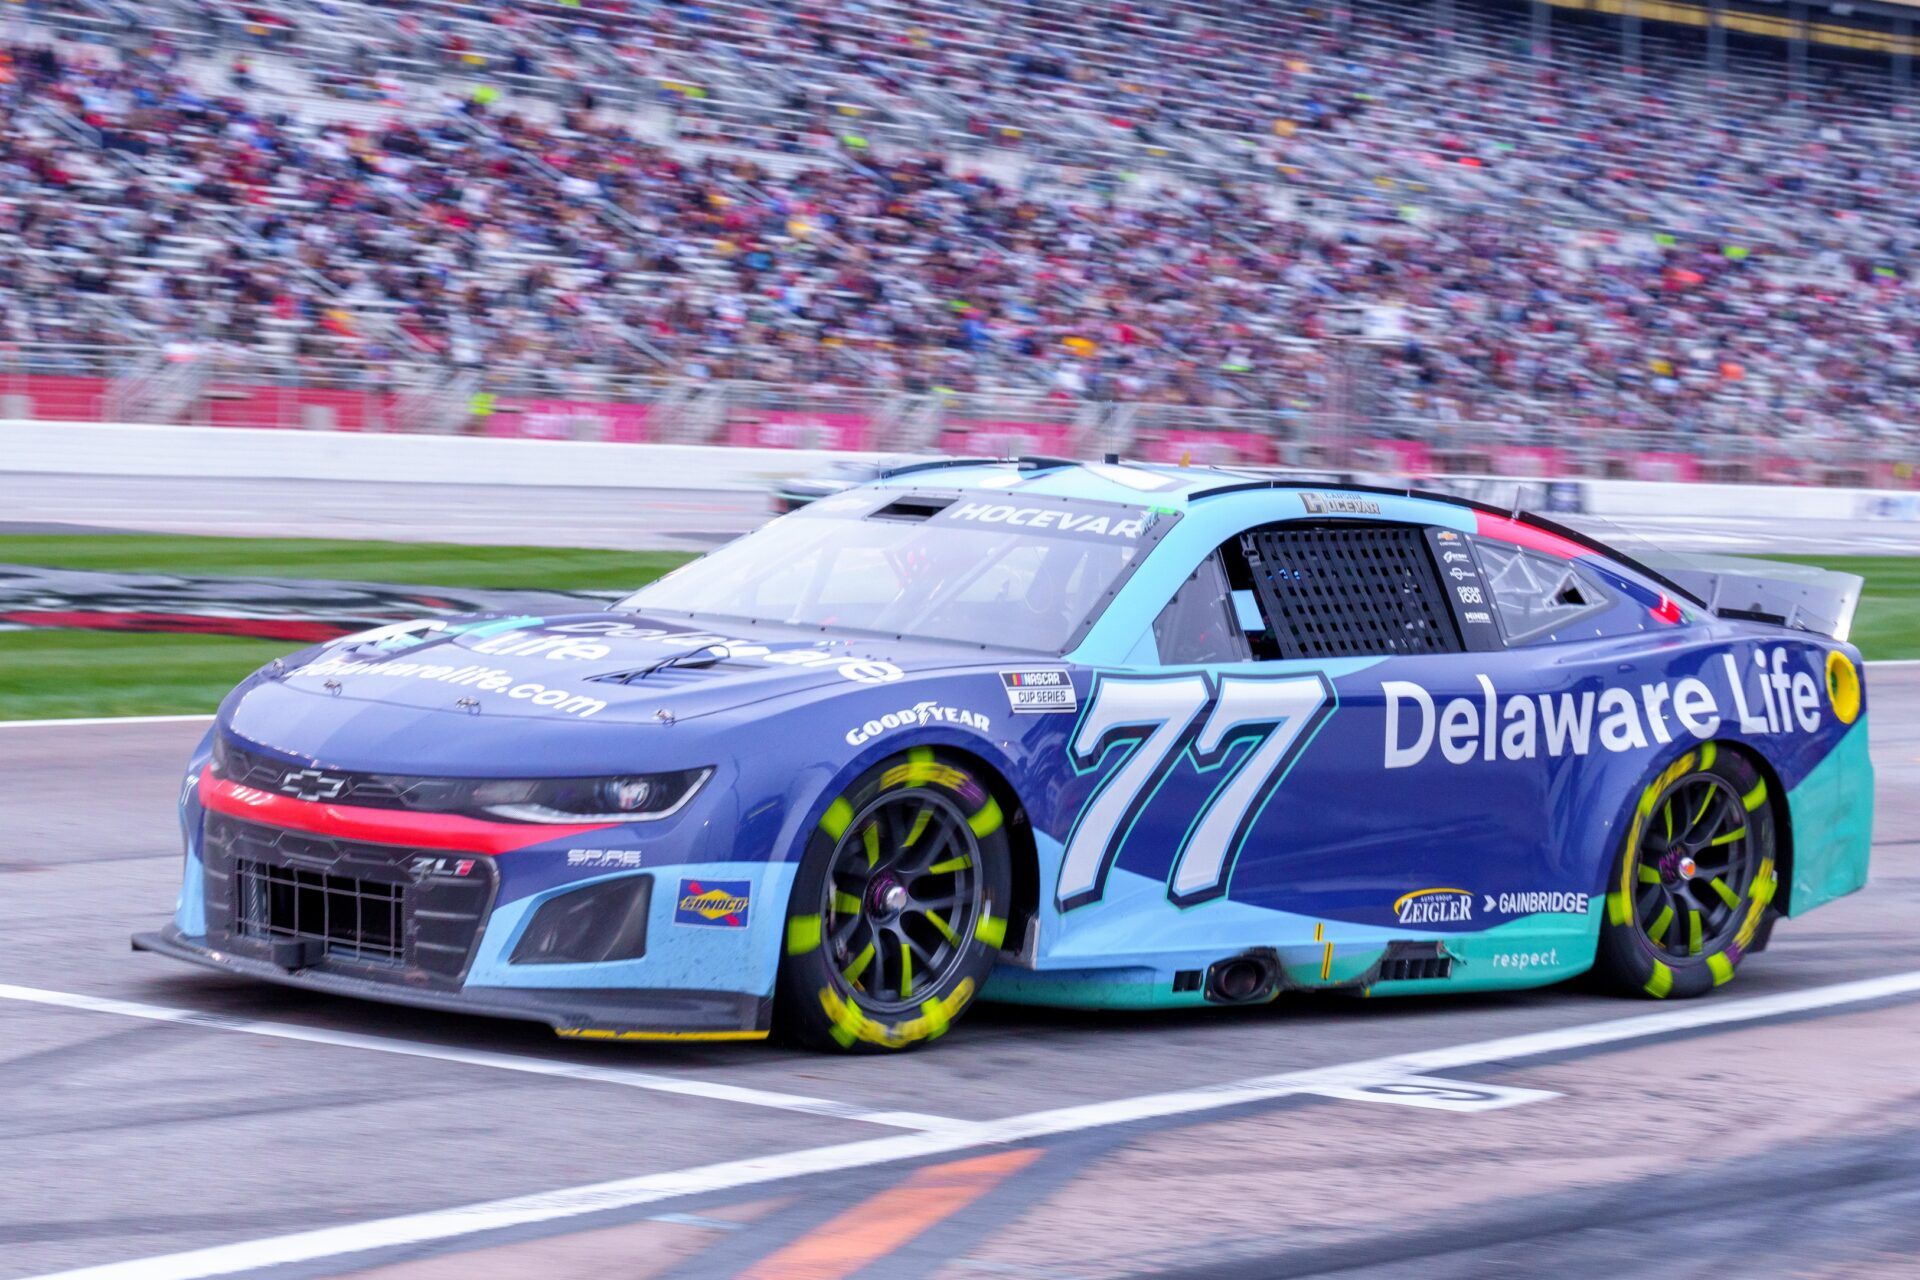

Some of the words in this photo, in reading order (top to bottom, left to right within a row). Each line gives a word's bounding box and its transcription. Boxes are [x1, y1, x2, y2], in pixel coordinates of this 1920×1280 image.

[950, 503, 1142, 539] HOCEVAR
[472, 630, 611, 661] Life
[1024, 673, 1060, 685] NASCAR
[1018, 691, 1035, 702] CUP
[1036, 691, 1066, 702] SERIES
[1381, 673, 1720, 769] Delaware
[1722, 647, 1821, 734] Life
[845, 701, 991, 746] GOODYEAR
[1055, 671, 1338, 914] 77
[408, 857, 476, 877] ZL1
[680, 896, 748, 913] SUNOCO
[1399, 895, 1472, 924] ZEIGLER
[1499, 892, 1588, 913] GAINBRIDGE
[1493, 948, 1560, 970] respect.
